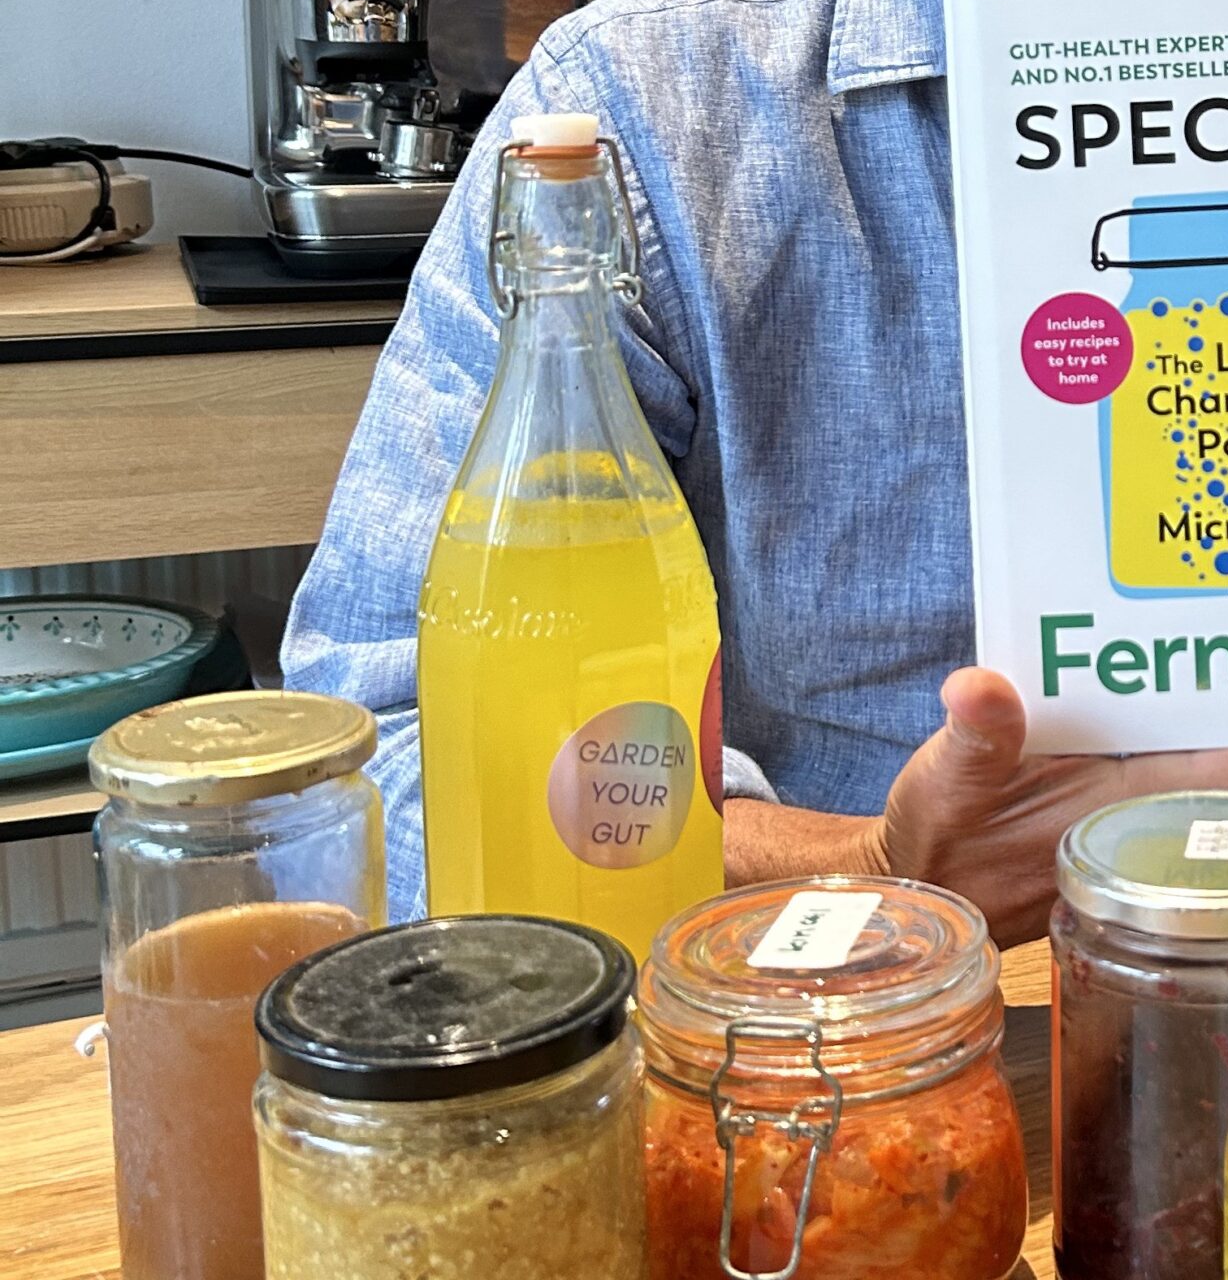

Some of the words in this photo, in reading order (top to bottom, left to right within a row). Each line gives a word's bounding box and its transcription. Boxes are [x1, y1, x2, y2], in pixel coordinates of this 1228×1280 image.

[1009, 37, 1150, 61] GUT-HEALTH
[1011, 67, 1059, 86] AND
[1065, 64, 1113, 84] NO.1
[1047, 316, 1105, 331] Includes
[1034, 338, 1067, 352] easy
[1070, 334, 1120, 350] recipes
[1048, 355, 1064, 367] to
[1067, 354, 1088, 368] try
[1091, 353, 1108, 365] at
[1155, 353, 1203, 375] The
[1059, 371, 1099, 384] home
[579, 740, 686, 768] GARDEN
[592, 781, 668, 807] YOUR
[591, 822, 652, 846] GUT
